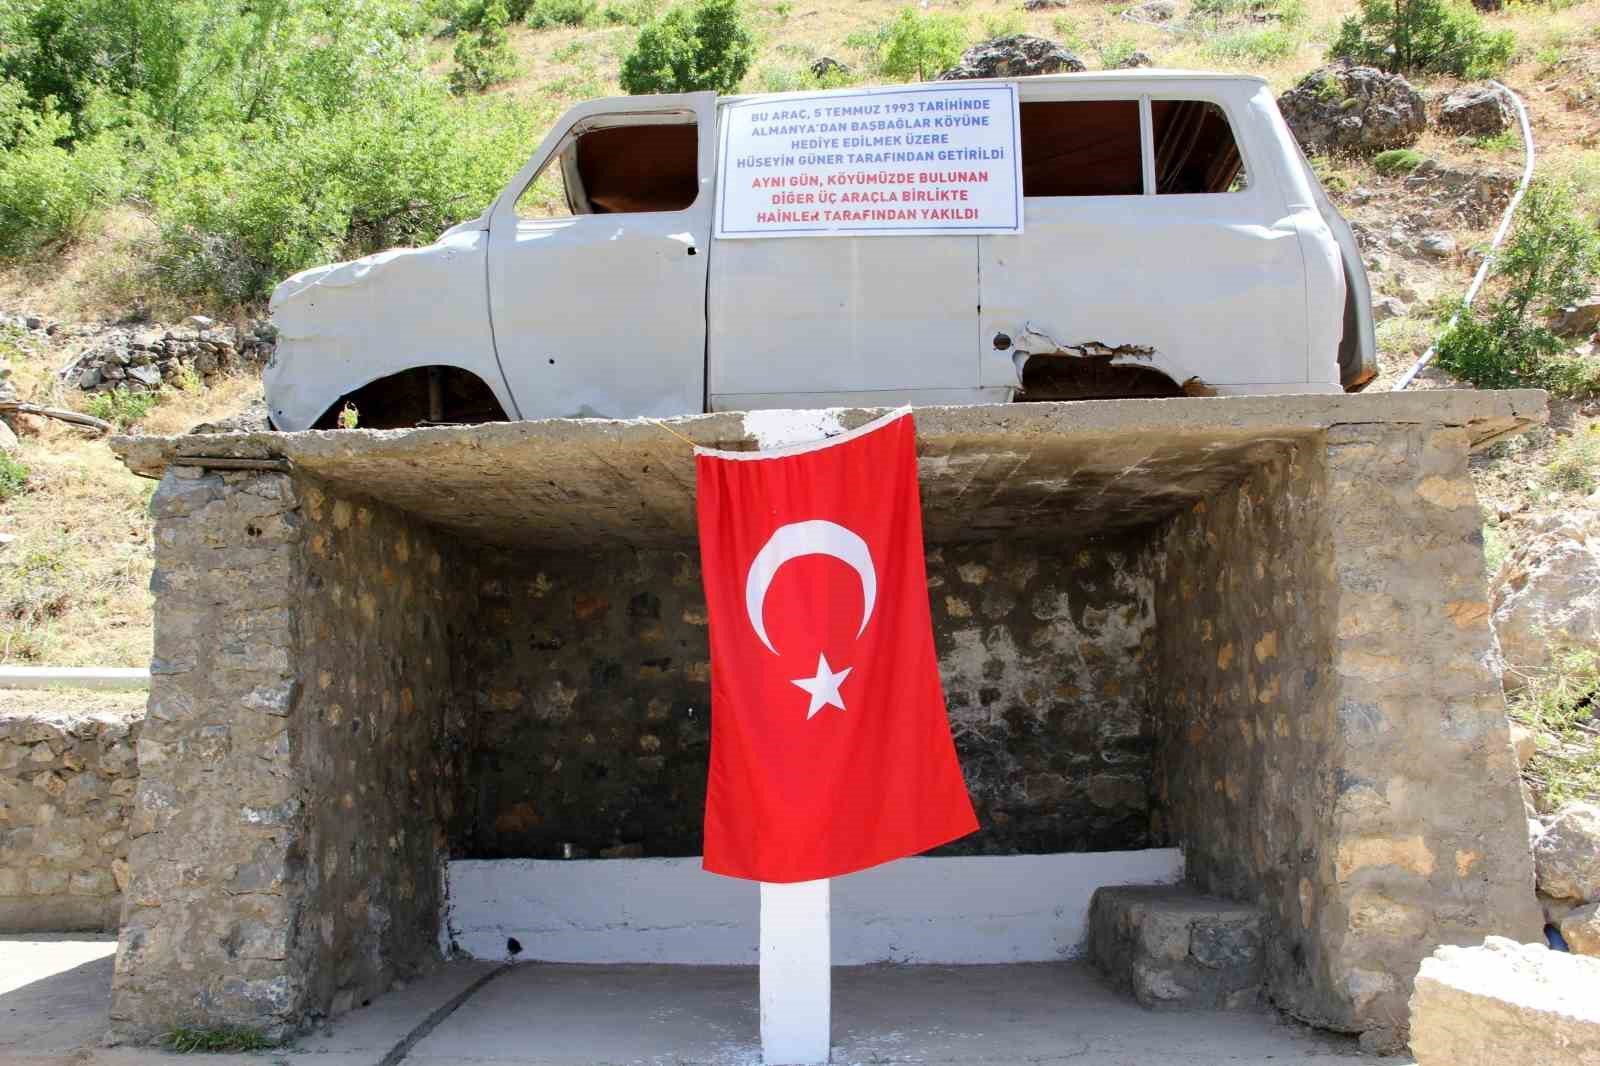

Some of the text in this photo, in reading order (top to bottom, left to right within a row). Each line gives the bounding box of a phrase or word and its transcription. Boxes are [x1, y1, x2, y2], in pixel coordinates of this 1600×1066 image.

[751, 111, 768, 122] BU
[814, 108, 821, 117] 5
[825, 104, 881, 117] TEMMUZ
[884, 103, 915, 114] 1993
[918, 98, 990, 112] TARİHİNDE
[850, 116, 931, 132] BAŞBAĞLAR
[934, 113, 990, 128] KÖYÜNE
[791, 132, 949, 150] HEDİYE EDİLMEK ÜZERE
[737, 146, 1004, 168] HÜSEYİN GÜNER TARAFINDAN GETİRİLDİ
[752, 171, 988, 188] AYNI GÜN, KÖYÜMÜZDE BULUNAN
[771, 187, 968, 205] DİĞER ÜÇ ARAÇLA BİRLİKTE
[823, 208, 917, 221] TARAFINDAN
[921, 207, 979, 220] YAKILDI
